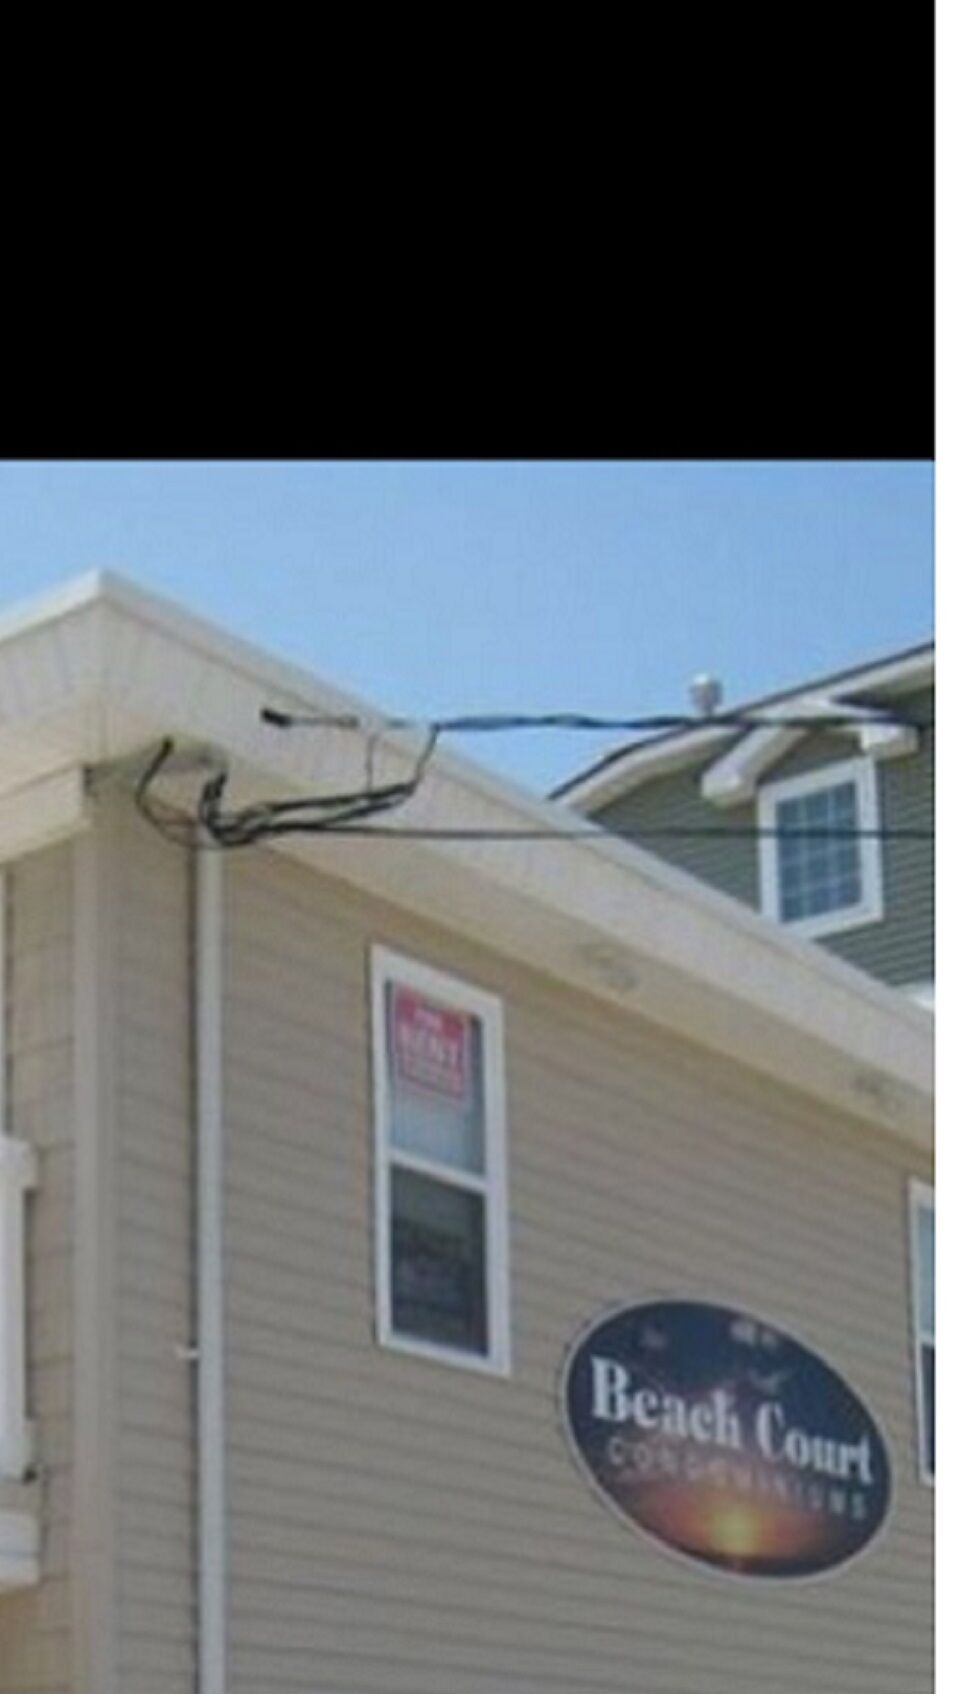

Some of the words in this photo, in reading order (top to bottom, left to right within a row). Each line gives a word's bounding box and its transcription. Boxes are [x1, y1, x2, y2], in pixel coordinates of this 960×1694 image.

[590, 1355, 741, 1449] Beach
[754, 1402, 874, 1486] Court
[607, 1435, 868, 1519] CONDOMINIUMS
